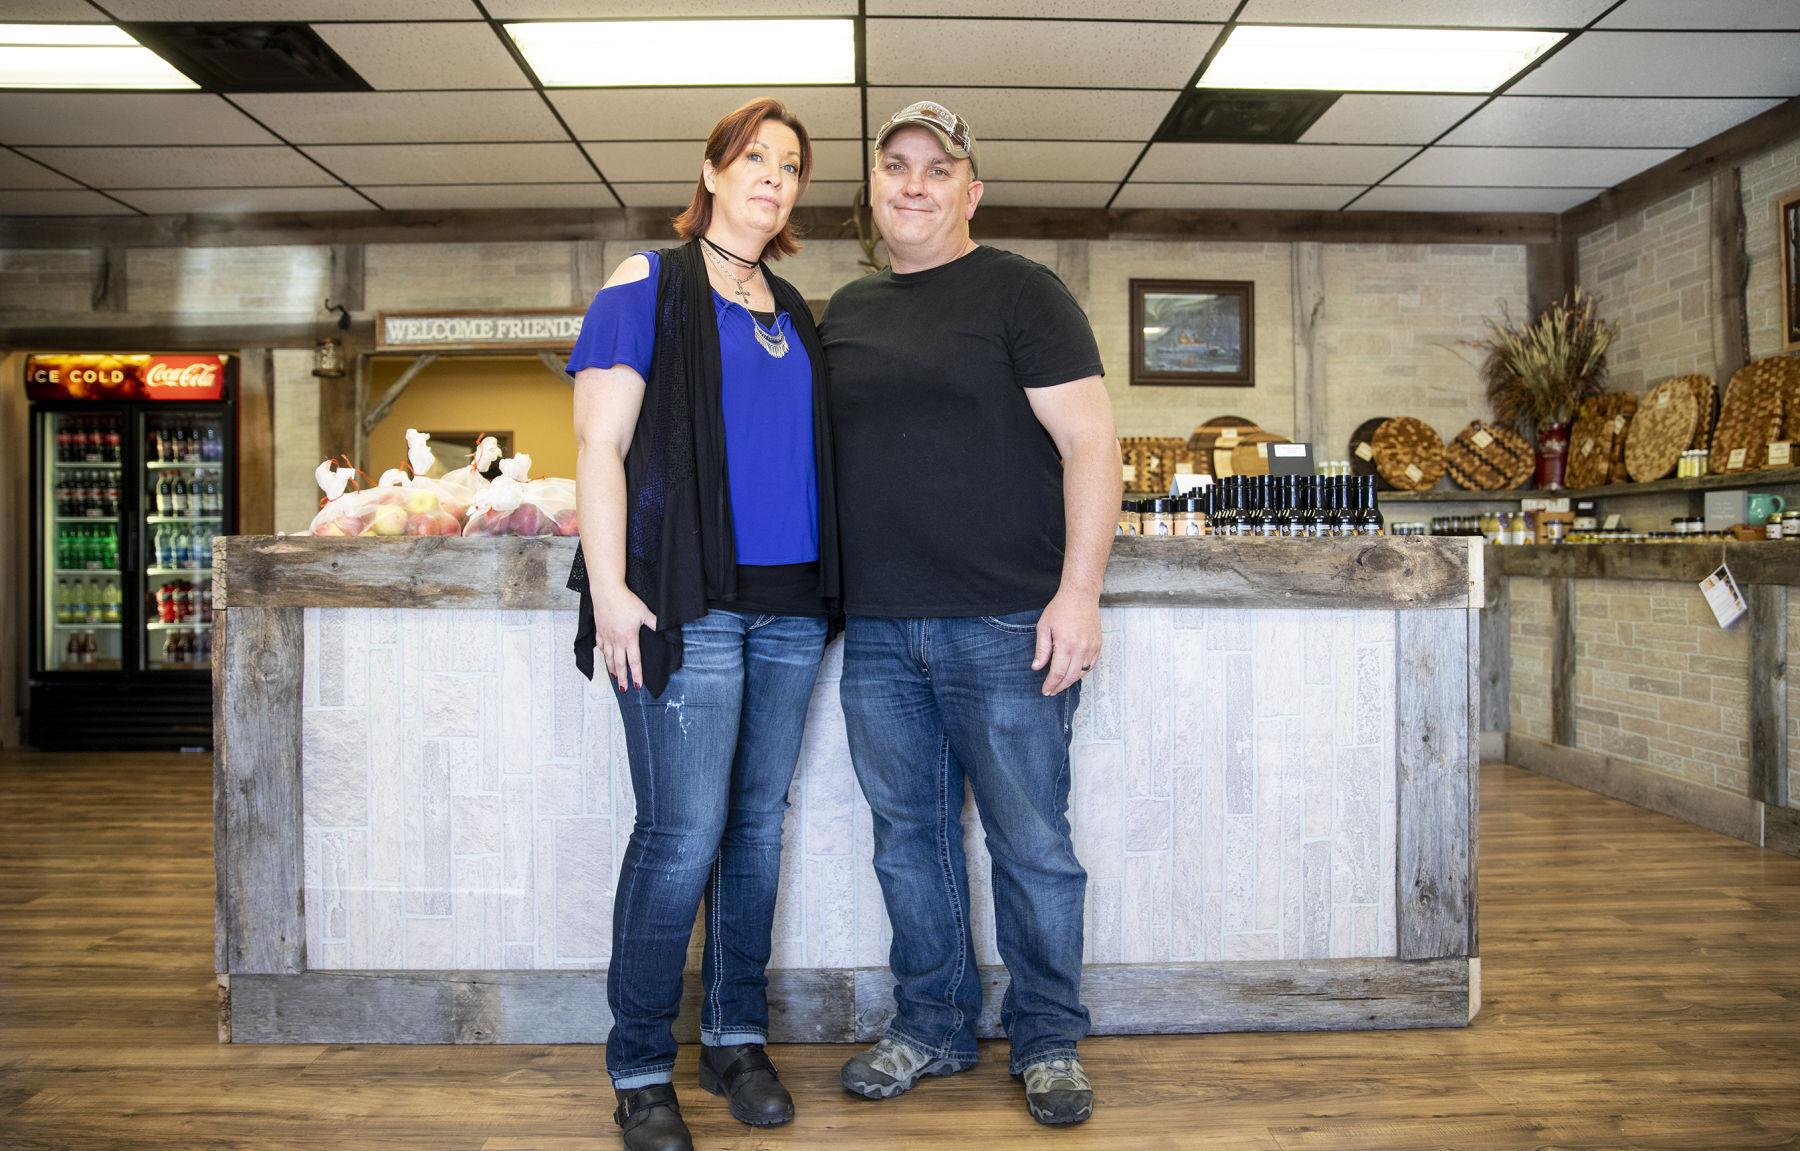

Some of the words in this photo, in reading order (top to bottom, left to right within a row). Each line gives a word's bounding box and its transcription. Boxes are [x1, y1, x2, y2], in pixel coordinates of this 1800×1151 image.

[386, 319, 495, 341] WELCOME
[496, 317, 582, 339] FRIENDS
[69, 369, 124, 383] COLD
